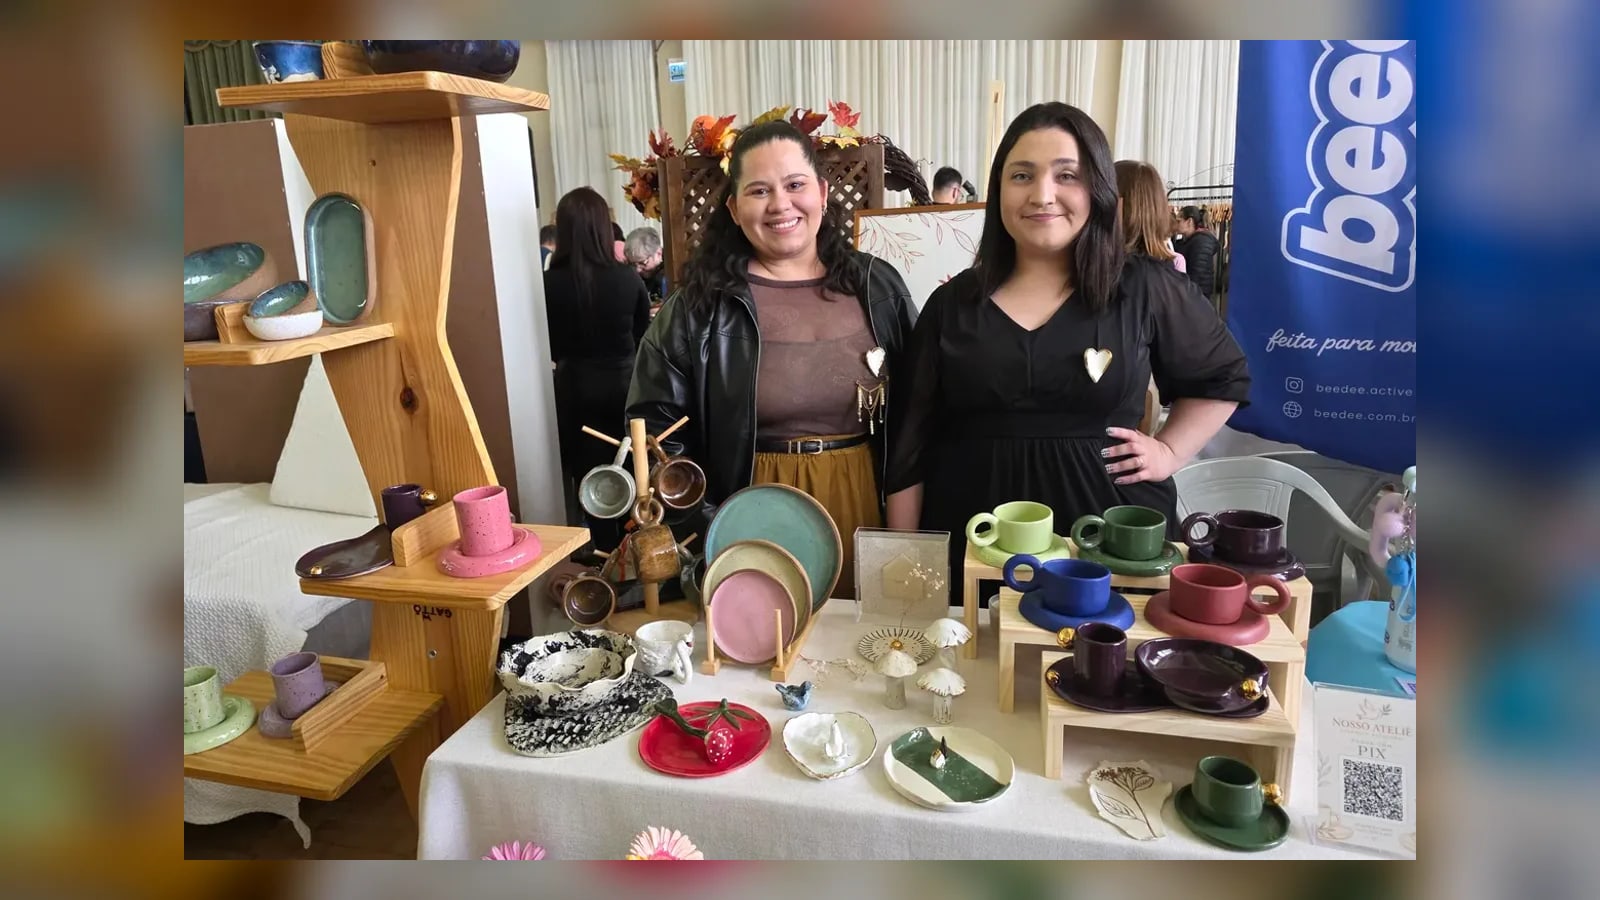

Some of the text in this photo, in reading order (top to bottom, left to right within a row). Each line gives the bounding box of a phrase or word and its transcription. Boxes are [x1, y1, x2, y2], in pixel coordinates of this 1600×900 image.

[1300, 39, 1413, 275] bee
[1266, 328, 1317, 352] feita
[1317, 338, 1375, 356] para
[1316, 384, 1413, 397] beedee.active
[1314, 408, 1416, 423] beedee.com.br
[1332, 718, 1370, 731] NOSSO
[1359, 745, 1385, 760] PIX
